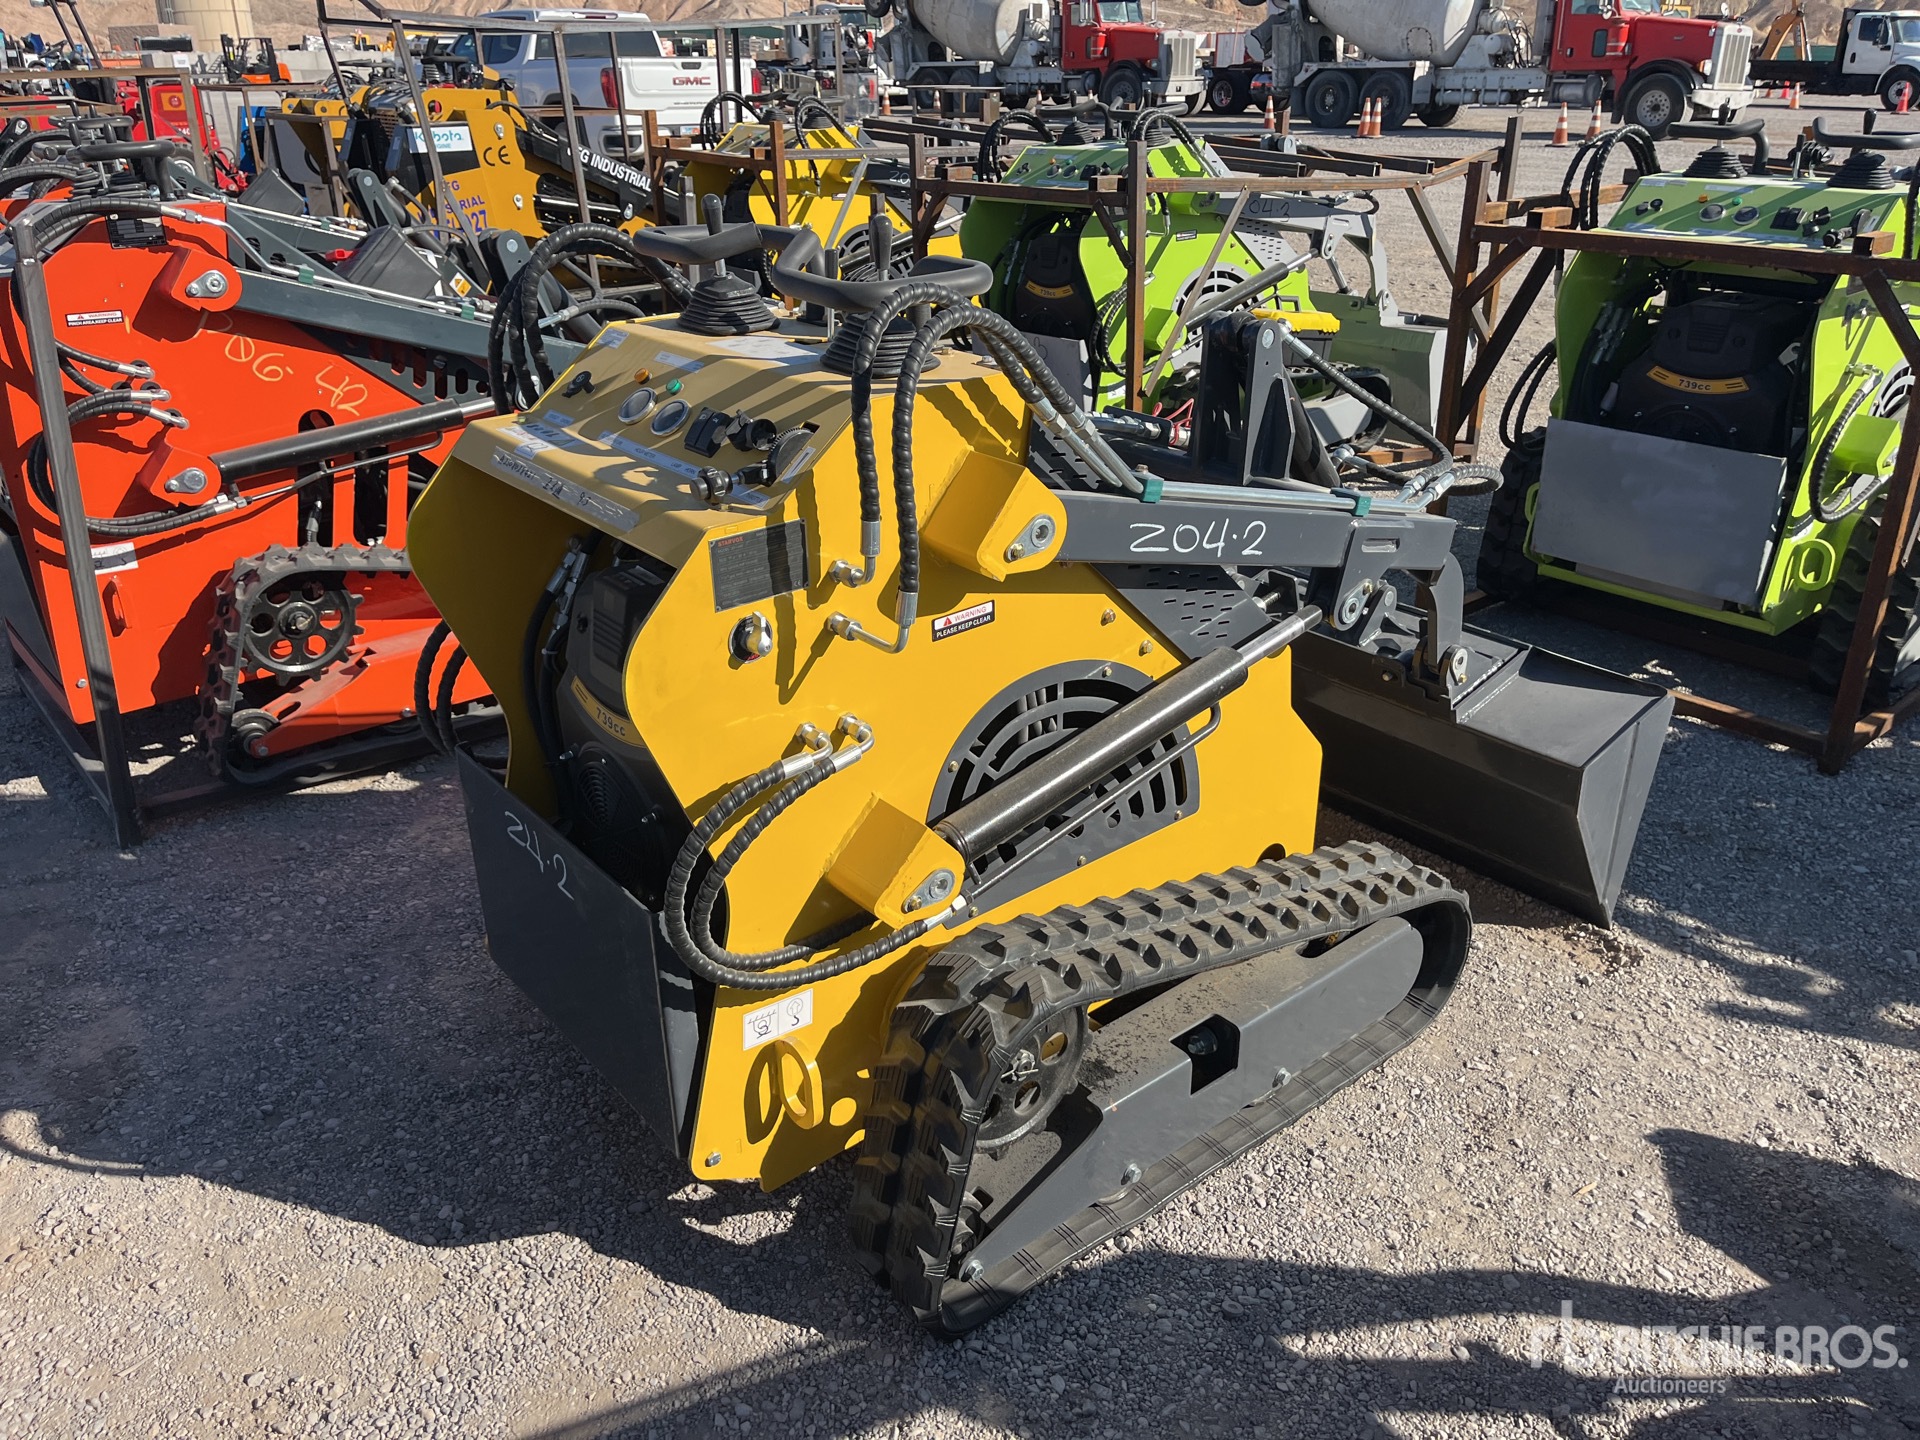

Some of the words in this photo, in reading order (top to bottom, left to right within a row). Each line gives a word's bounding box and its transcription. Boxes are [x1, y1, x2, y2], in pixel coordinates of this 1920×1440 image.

[672, 77, 711, 85] GMC
[591, 155, 651, 192] INDUSTRIAL
[1679, 378, 1711, 391] 739cc
[717, 536, 744, 548] STARVOX
[954, 606, 988, 622] WARNING
[936, 626, 958, 638] PLEASE
[958, 620, 973, 631] KEEP
[973, 614, 992, 626] CLEAR
[596, 706, 626, 737] 739cc
